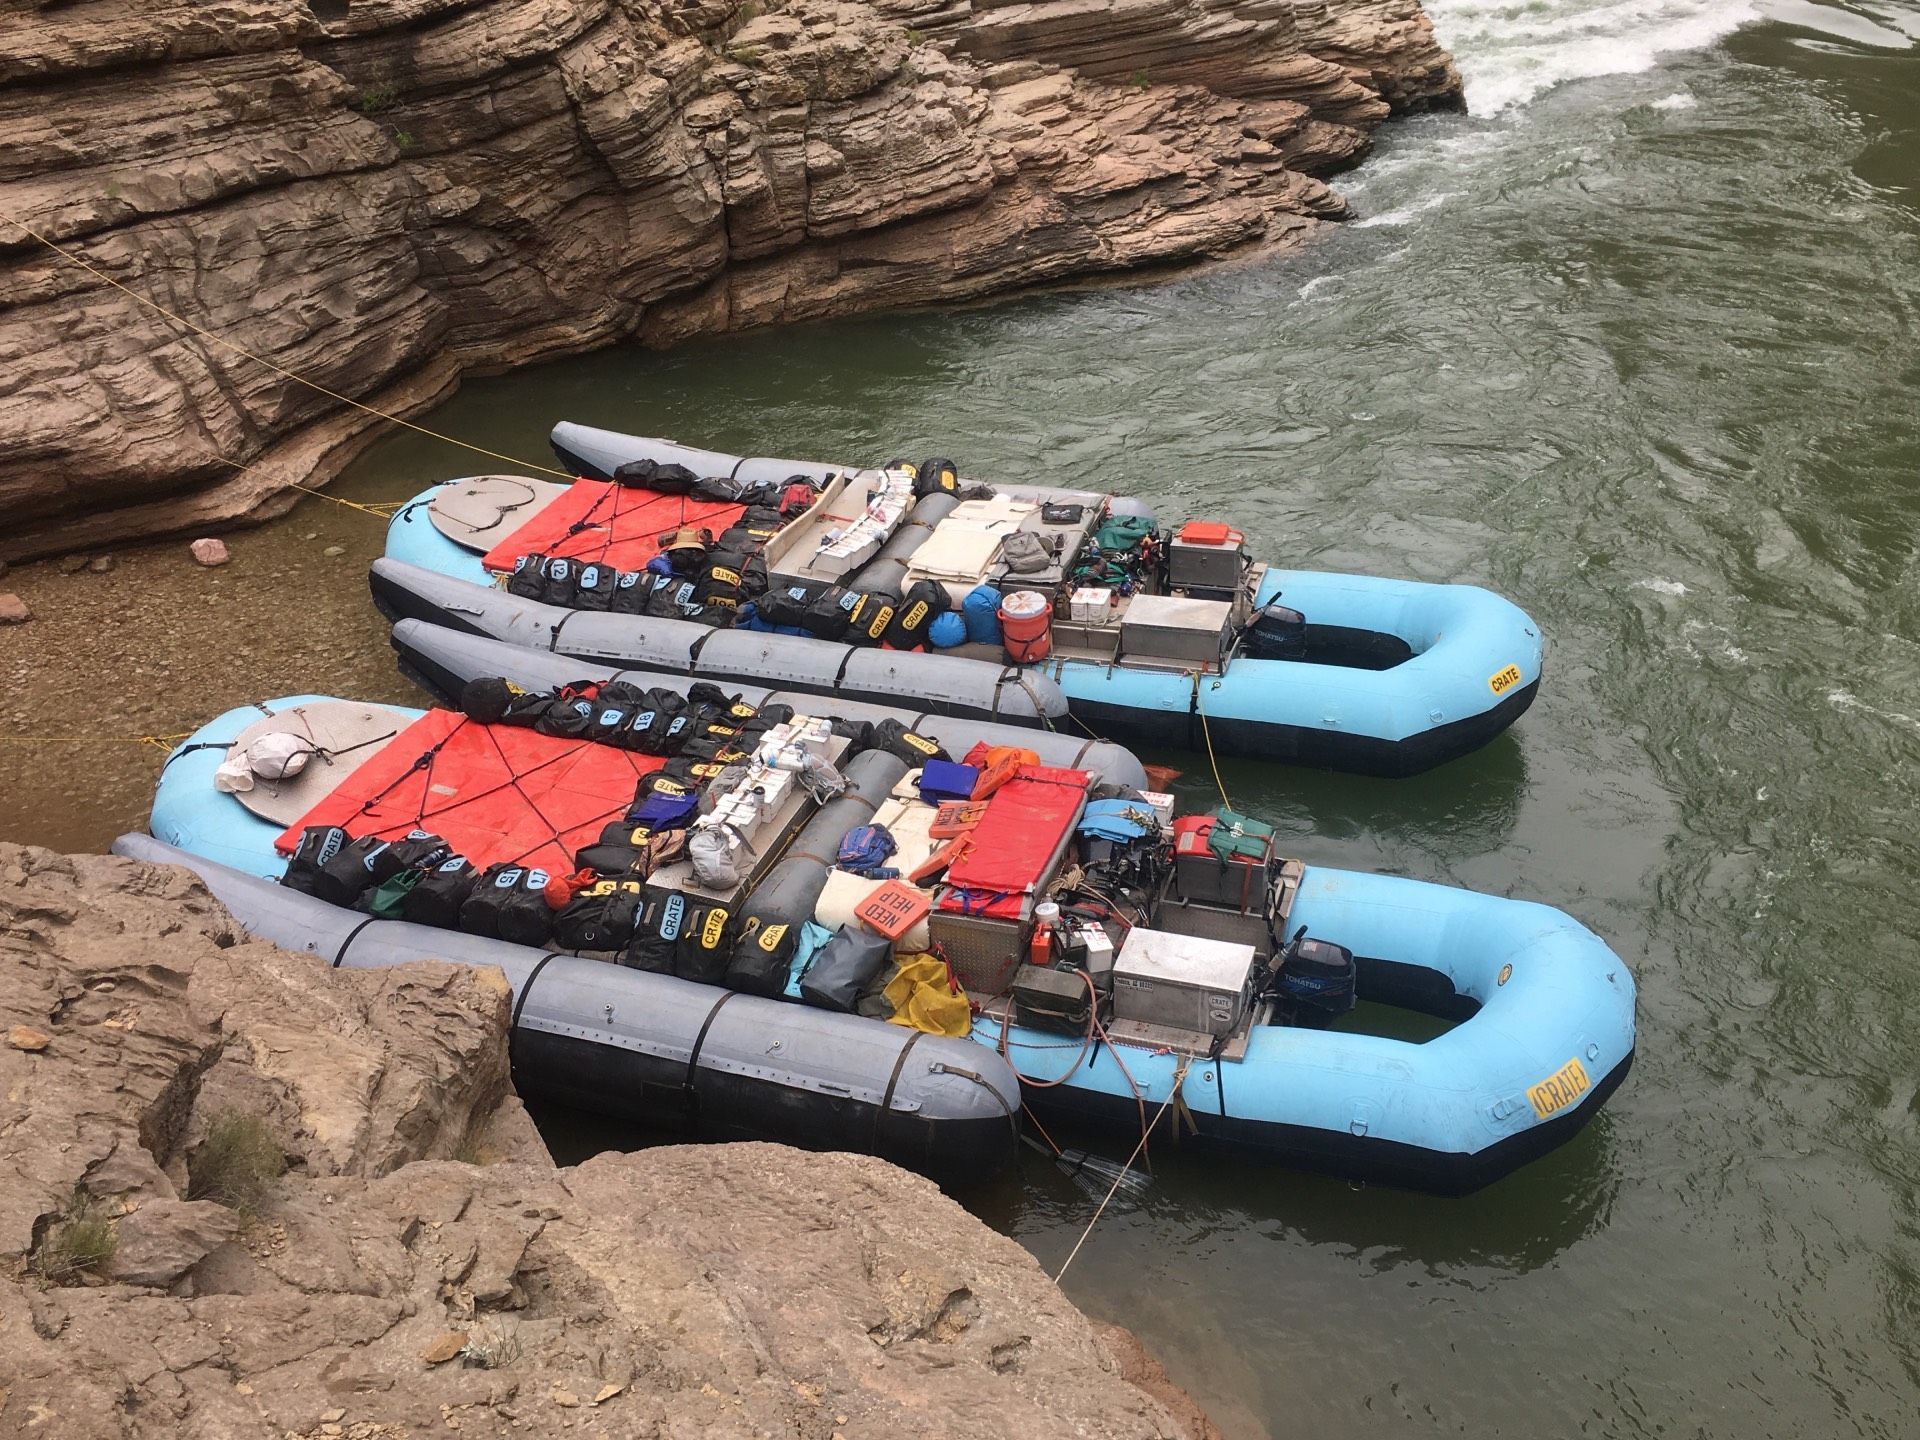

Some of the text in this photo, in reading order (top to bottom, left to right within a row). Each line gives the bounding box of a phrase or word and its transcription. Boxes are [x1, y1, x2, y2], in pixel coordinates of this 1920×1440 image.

[553, 563, 565, 577] 12
[583, 573, 595, 581] 7
[842, 592, 859, 609] CRAT
[871, 609, 892, 636] CRATE
[905, 603, 927, 628] CRATE
[1491, 667, 1519, 692] CRATE
[637, 714, 651, 727] 18
[906, 734, 934, 752] CRATE
[321, 831, 342, 864] CRATE
[500, 869, 518, 883] 15
[530, 871, 548, 884] 17
[878, 891, 916, 914] HELP
[664, 898, 682, 936] CRATE
[864, 903, 901, 928] NEED
[705, 910, 725, 944] CRATE
[762, 925, 783, 947] CRAT
[1285, 974, 1321, 990] TOHATSU
